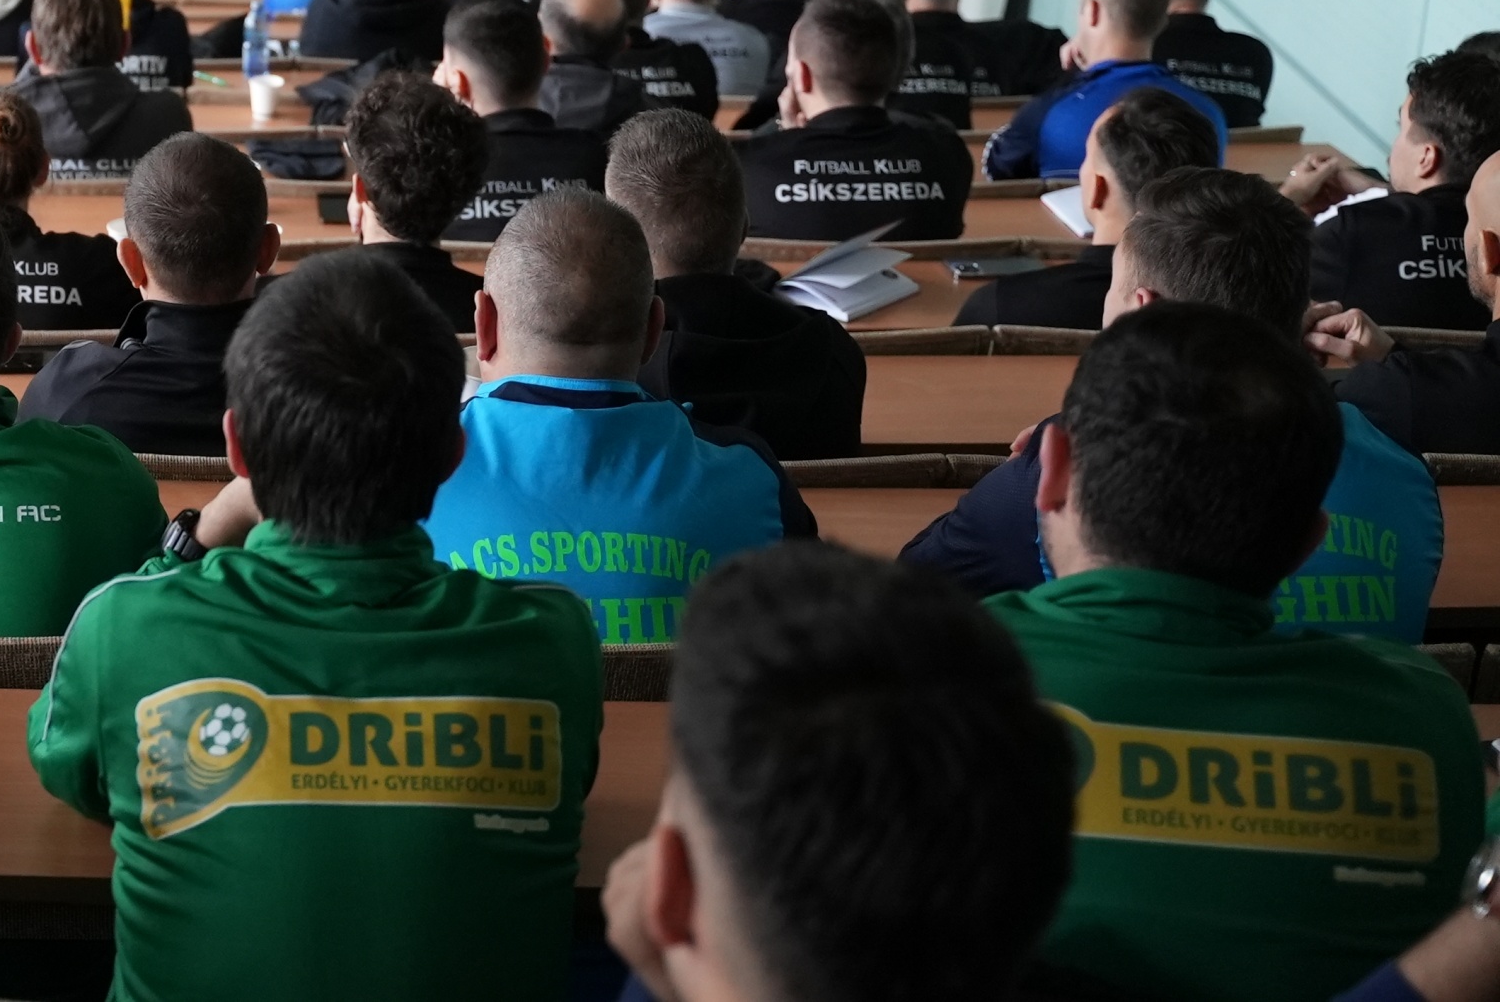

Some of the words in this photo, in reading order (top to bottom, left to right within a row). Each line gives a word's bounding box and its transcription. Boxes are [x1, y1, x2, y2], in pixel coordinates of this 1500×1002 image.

[794, 159, 871, 175] FUTBALL
[873, 159, 922, 174] KLUB
[775, 178, 945, 203] CSÍKSZEREDA
[17, 505, 62, 523] AC
[291, 772, 368, 791] ERDÉLYI
[384, 775, 495, 794] GYEREKFOCI
[508, 778, 548, 796] KLUB
